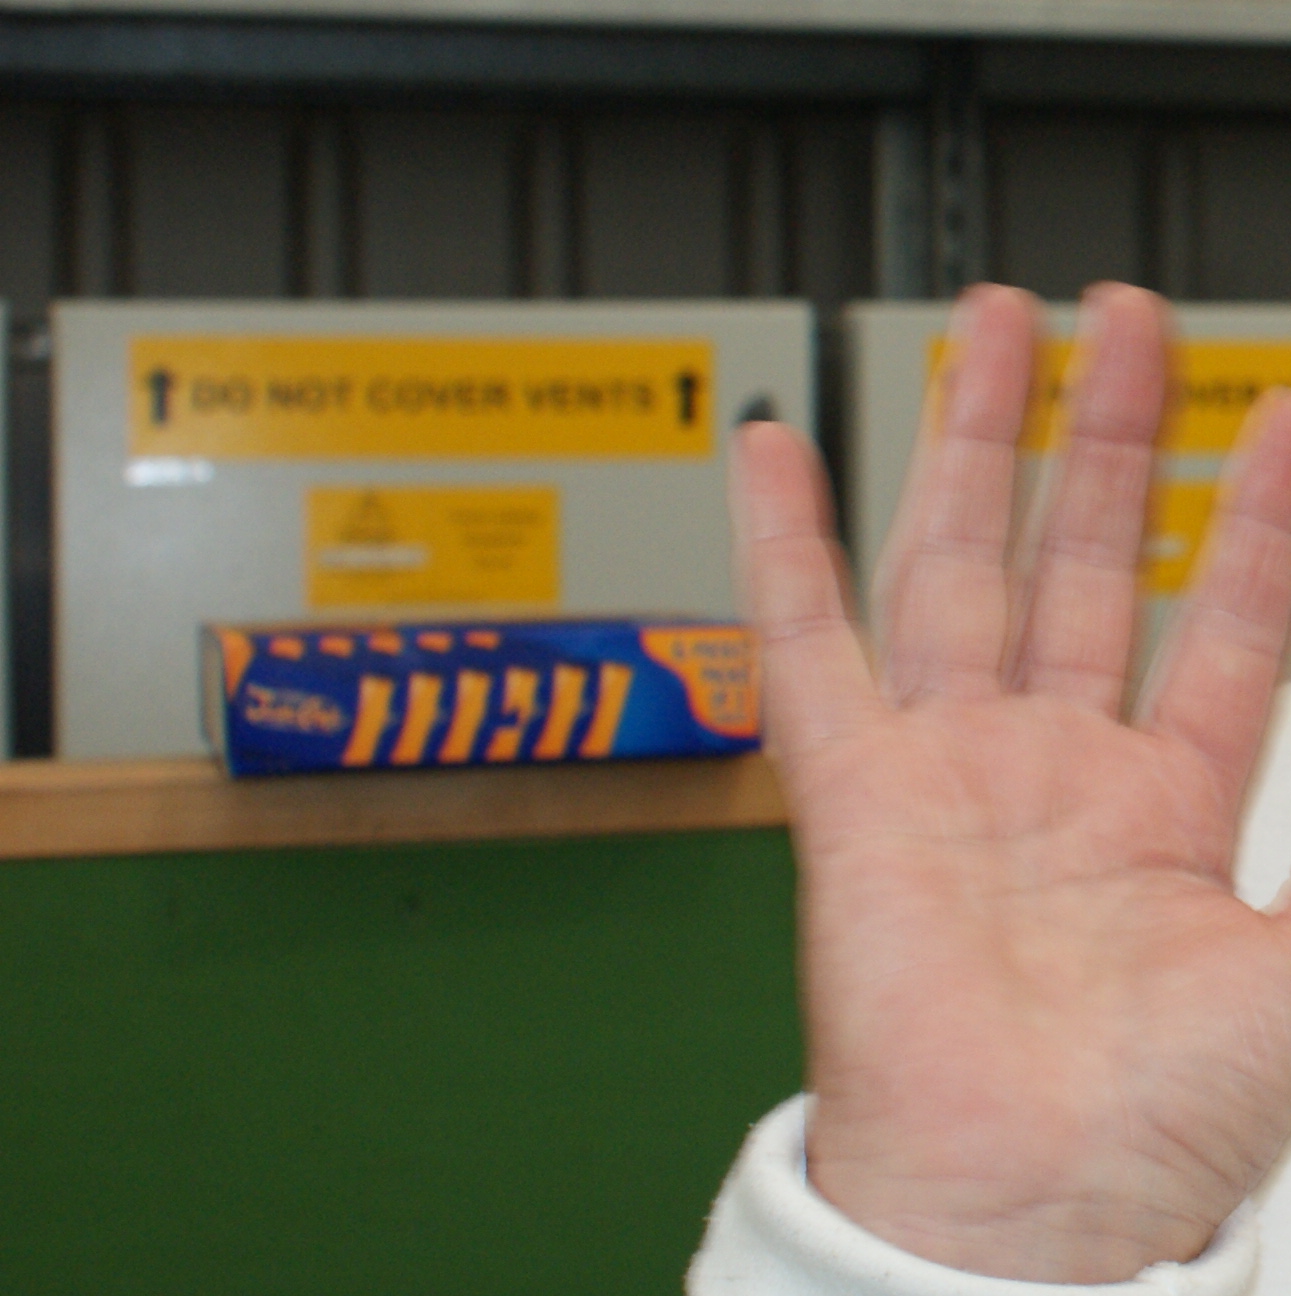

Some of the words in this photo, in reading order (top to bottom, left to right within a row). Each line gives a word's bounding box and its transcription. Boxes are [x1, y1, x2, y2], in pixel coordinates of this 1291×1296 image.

[188, 375, 254, 416] DO
[265, 375, 352, 415] NOT
[364, 375, 511, 415] COVER
[522, 376, 655, 415] VENTS
